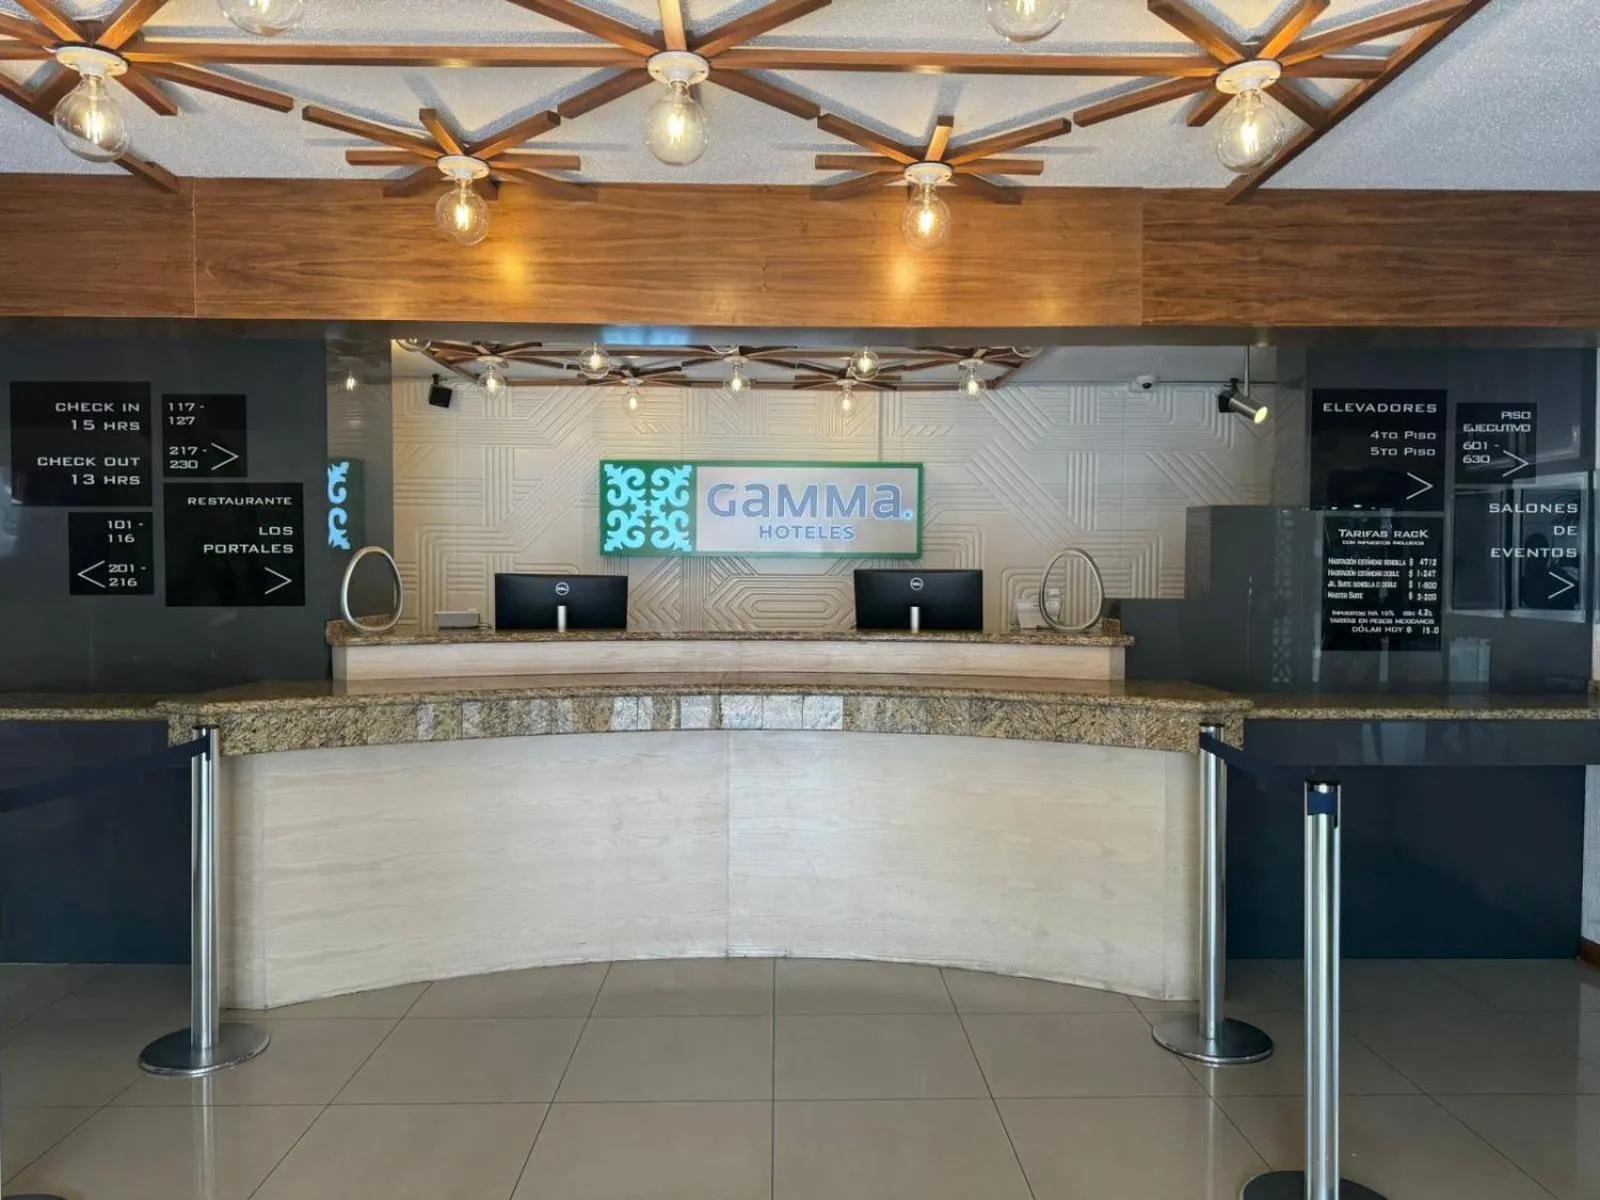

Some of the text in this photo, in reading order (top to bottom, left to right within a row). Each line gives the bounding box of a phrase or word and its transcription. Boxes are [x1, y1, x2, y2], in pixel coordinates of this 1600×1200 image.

[55, 402, 140, 413] CHECK IN
[169, 402, 196, 412] 117
[1323, 402, 1437, 413] ELEVADORES
[169, 415, 196, 426] 127
[1500, 411, 1532, 420] PISO
[71, 419, 141, 431] 15 HRS
[1463, 423, 1531, 433] EJECUTIVO
[169, 446, 198, 456] 217
[1462, 440, 1488, 451] 601
[37, 456, 140, 467] CHECK OUT
[169, 459, 199, 470] 230
[1462, 454, 1491, 465] 630
[71, 473, 141, 486] 13 HRS
[187, 496, 292, 506] RESTAURANTE
[1488, 502, 1578, 514] SALONES
[107, 520, 132, 530] 101
[1553, 525, 1578, 536] DE
[258, 526, 294, 536] LOS
[758, 525, 855, 540] HOTELES
[107, 533, 135, 544] 116
[203, 543, 294, 554] PORTALES
[1490, 547, 1577, 559] EVENTOS
[108, 563, 135, 573] 201
[108, 577, 138, 587] 216
